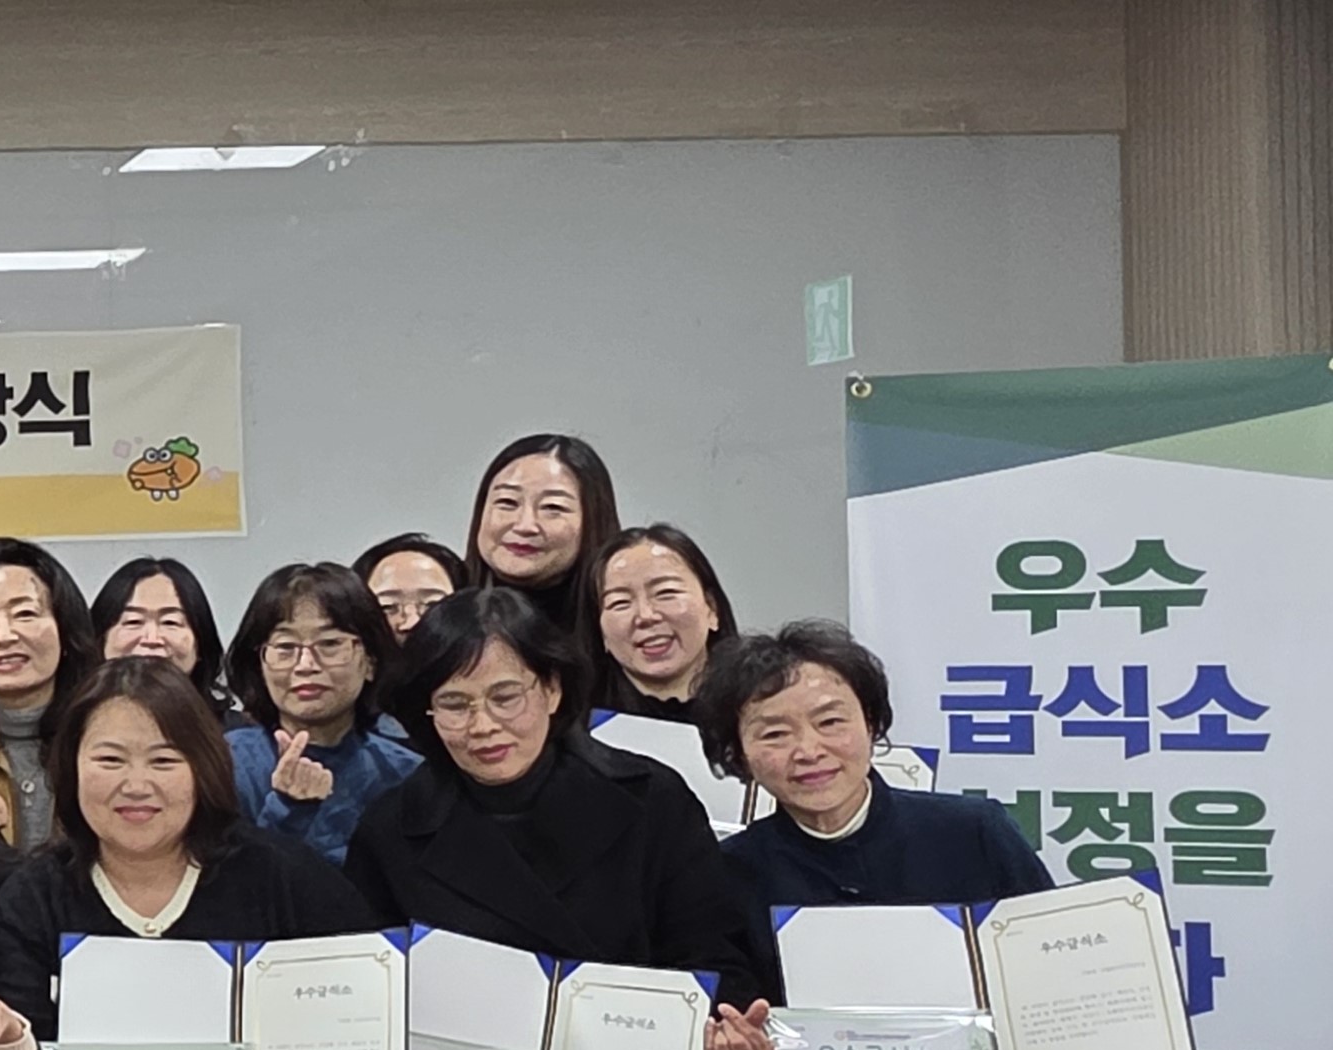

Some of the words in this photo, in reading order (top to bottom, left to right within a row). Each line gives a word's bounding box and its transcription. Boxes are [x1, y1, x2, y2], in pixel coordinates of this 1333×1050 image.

[992, 538, 1208, 634] 우수
[939, 664, 1271, 759] 급식소
[963, 789, 1276, 887] 정을
[1040, 933, 1108, 953] 우수급식소
[294, 983, 353, 999] 우수급식소
